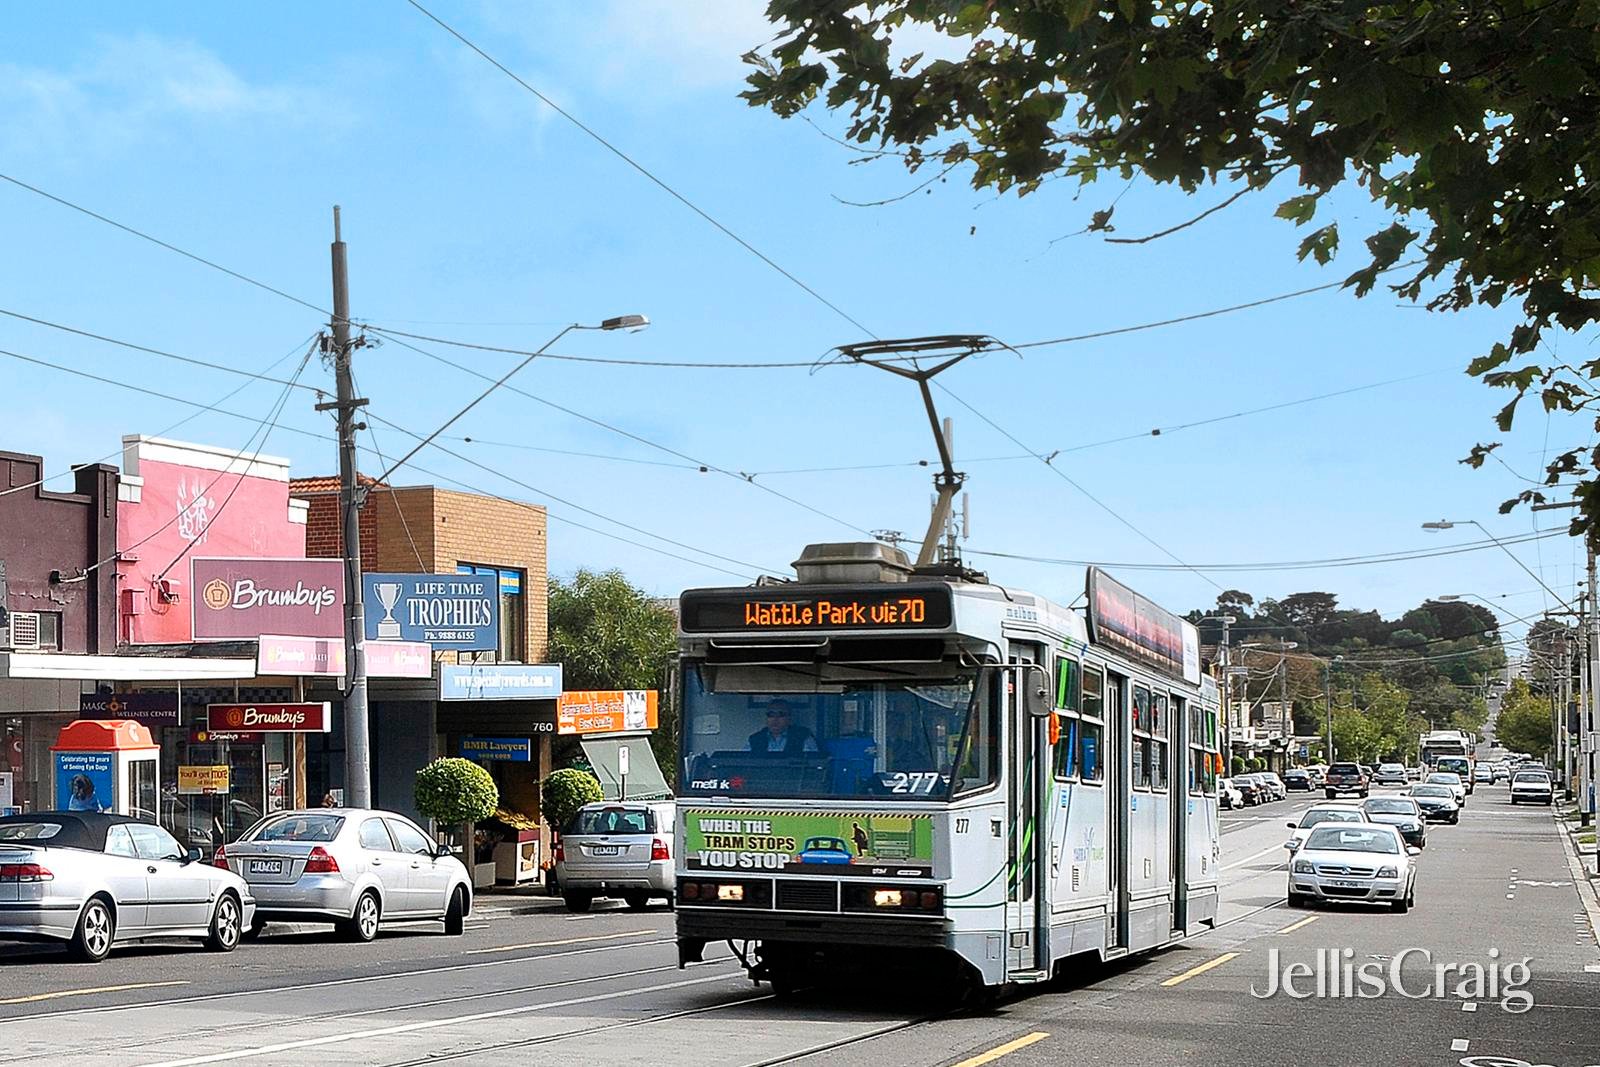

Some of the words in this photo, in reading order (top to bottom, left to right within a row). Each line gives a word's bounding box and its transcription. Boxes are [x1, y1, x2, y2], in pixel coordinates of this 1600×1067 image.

[232, 579, 336, 615] Brumby's
[415, 583, 446, 595] LIFE
[449, 583, 483, 595] TIME
[406, 598, 491, 626] TROPHIES
[745, 603, 812, 625] Wattle
[817, 601, 866, 624] Park
[899, 599, 925, 623] 70
[243, 708, 305, 728] Brumby's
[533, 723, 553, 732] 760
[489, 741, 527, 752] Lawyers
[892, 772, 939, 793] 277
[699, 819, 741, 834] WHEN
[743, 820, 771, 835] THE
[956, 818, 969, 833] 277
[705, 835, 744, 850] TRAM
[748, 836, 795, 851] STOPS
[697, 850, 740, 868] YOU
[739, 851, 791, 870] STOP
